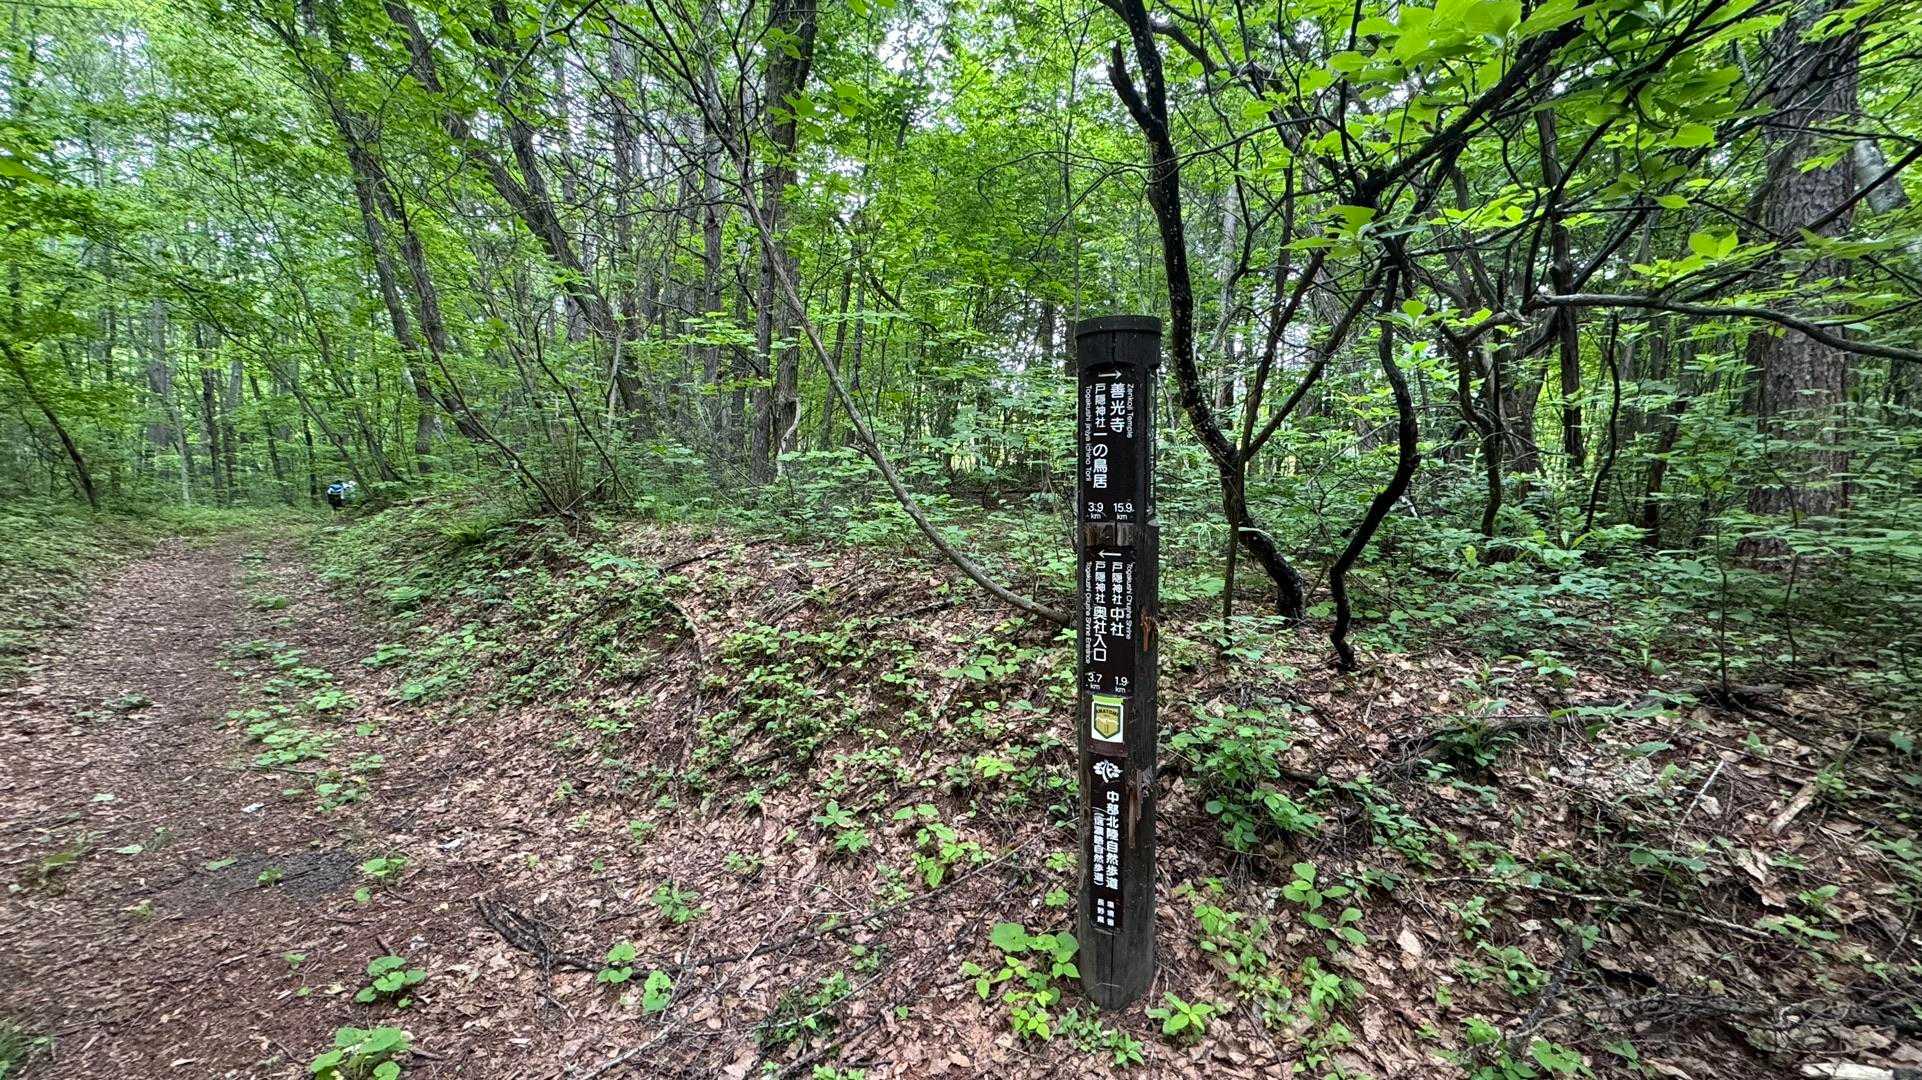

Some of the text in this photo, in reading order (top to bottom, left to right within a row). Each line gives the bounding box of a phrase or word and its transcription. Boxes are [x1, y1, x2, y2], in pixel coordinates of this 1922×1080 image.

[1085, 385, 1093, 421] Togakushi
[1110, 382, 1126, 433] 善光寺
[1126, 383, 1135, 439] Zenkoji Temple
[1087, 501, 1104, 512] 3.9
[1090, 512, 1102, 520] km
[1113, 502, 1132, 513] 15.9
[1093, 560, 1107, 662] 戸隠神社奥社入口
[1110, 561, 1125, 637] 戸隠神社中社
[1125, 620, 1133, 640] Shrine
[1087, 672, 1103, 683] 3.7
[1114, 676, 1129, 686] 1.9
[1106, 790, 1120, 890] 中部北陸自然歩道
